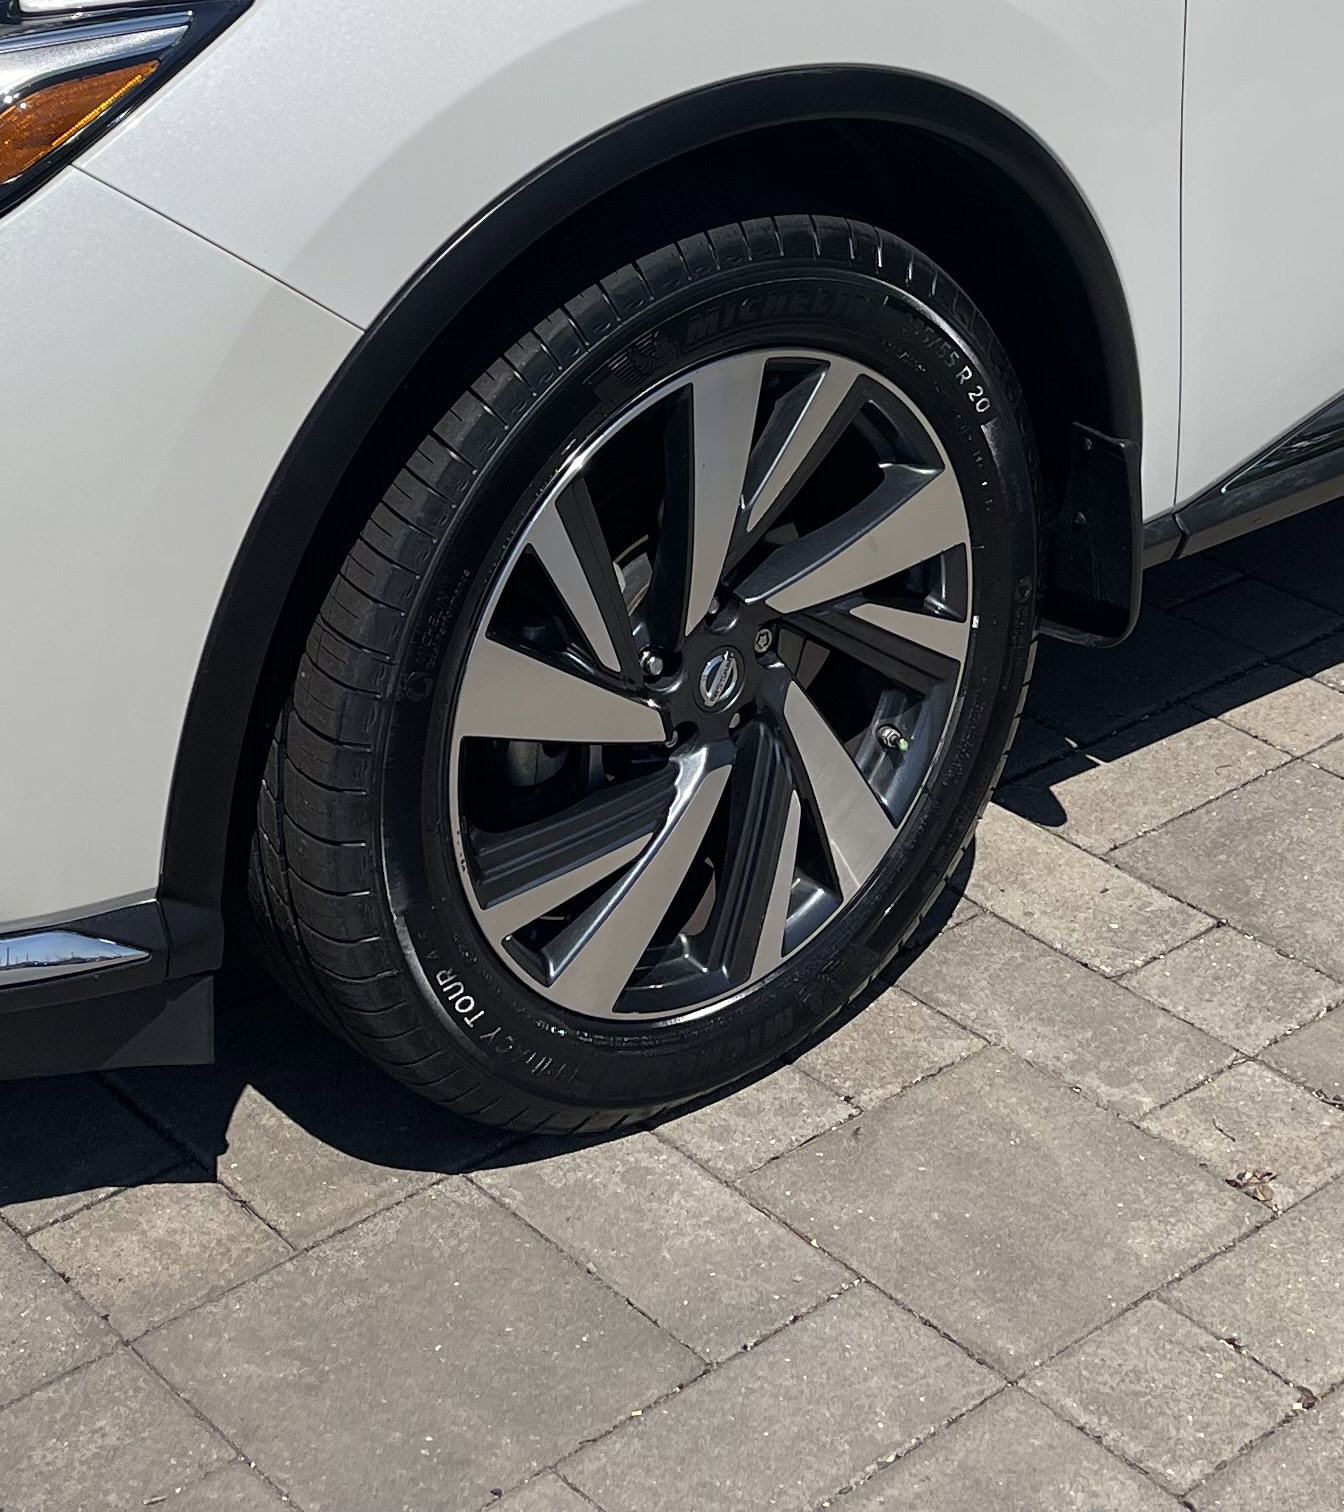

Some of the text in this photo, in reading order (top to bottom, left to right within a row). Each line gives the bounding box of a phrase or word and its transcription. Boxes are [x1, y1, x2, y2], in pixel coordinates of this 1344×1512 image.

[686, 287, 872, 347] MICHELIN
[953, 364, 974, 386] R
[966, 384, 992, 413] 20
[434, 966, 486, 1029] TOUR
